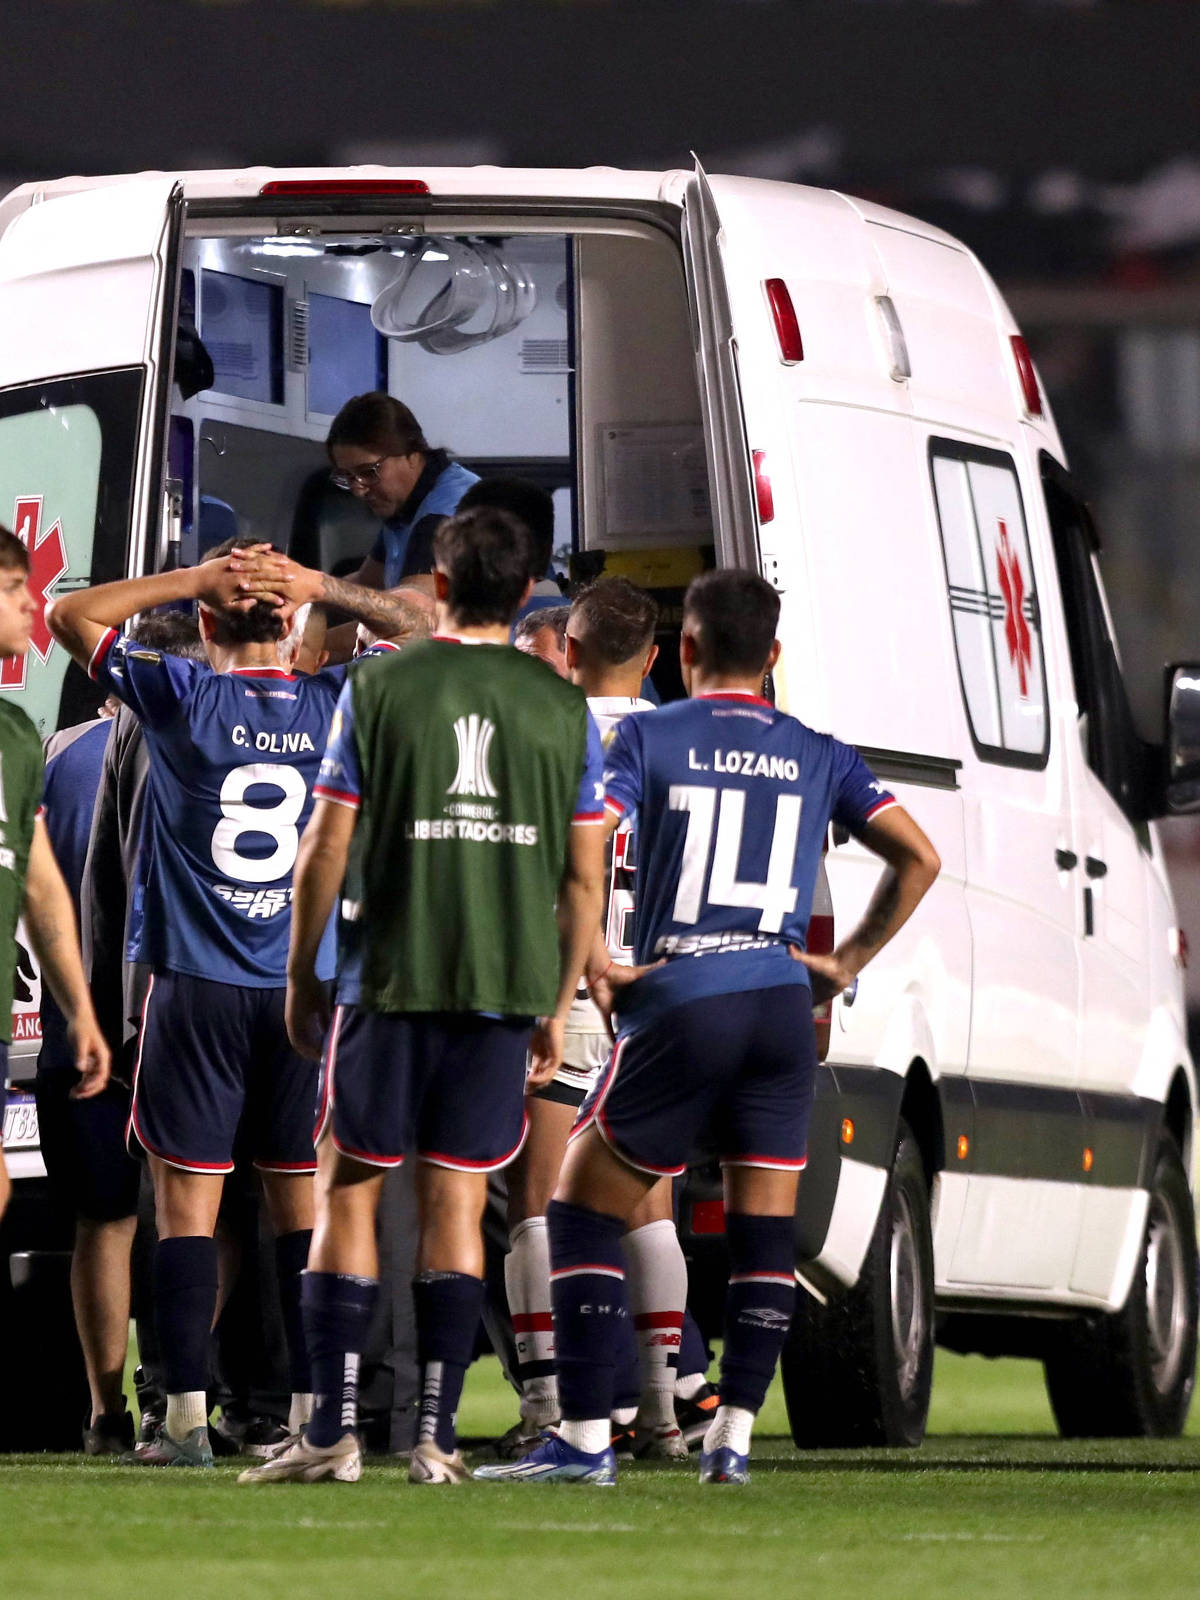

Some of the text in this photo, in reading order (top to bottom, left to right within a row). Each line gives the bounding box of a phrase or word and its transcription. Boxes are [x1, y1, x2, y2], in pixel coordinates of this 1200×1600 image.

[231, 725, 315, 753] C. OLIVA
[688, 748, 800, 783] L. LOZANO
[211, 763, 306, 883] 8
[668, 784, 803, 934] 14
